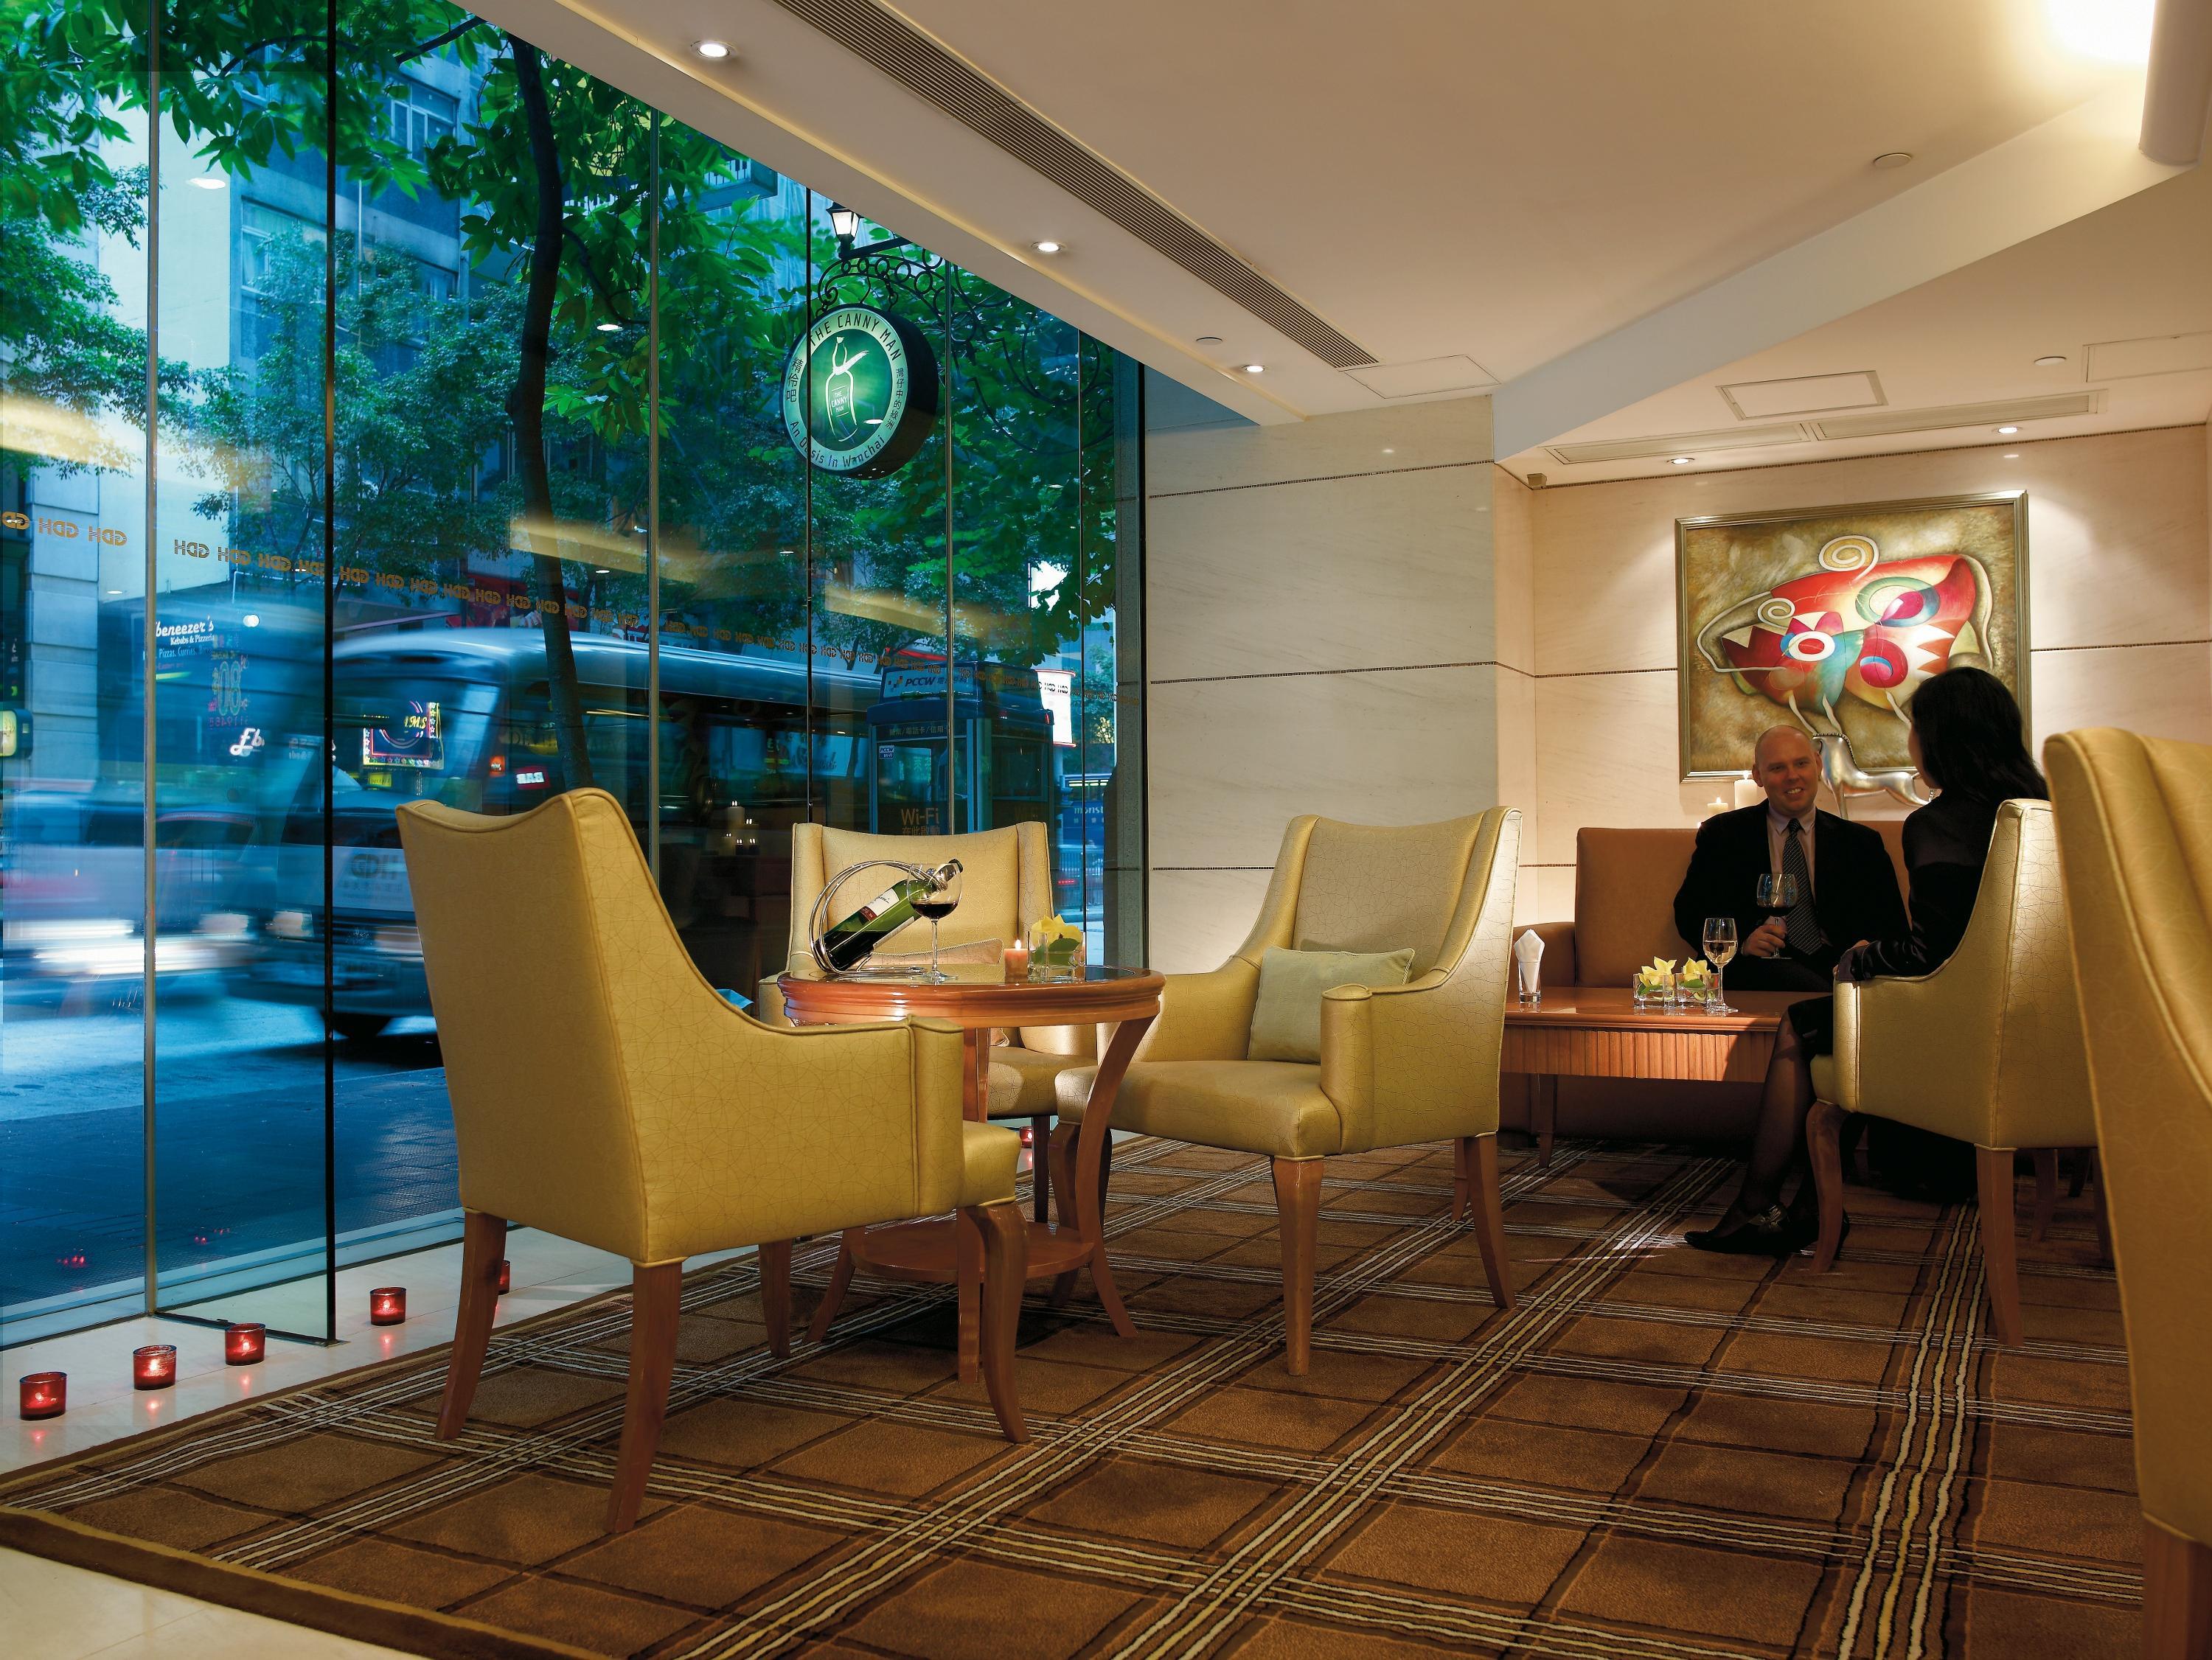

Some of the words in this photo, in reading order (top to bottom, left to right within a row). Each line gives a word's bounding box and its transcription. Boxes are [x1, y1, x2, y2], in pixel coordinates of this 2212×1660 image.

[810, 326, 832, 347] THE
[837, 313, 880, 331] CANNY
[880, 330, 902, 361] MAN
[790, 421, 801, 438] An
[799, 436, 824, 464] Osis
[828, 455, 838, 467] In
[843, 435, 885, 467] Wanchai
[156, 615, 214, 638] beneezer's
[170, 635, 189, 646] Kebabs
[905, 677, 935, 687] PCCW
[901, 808, 940, 826] Wi-Fi
